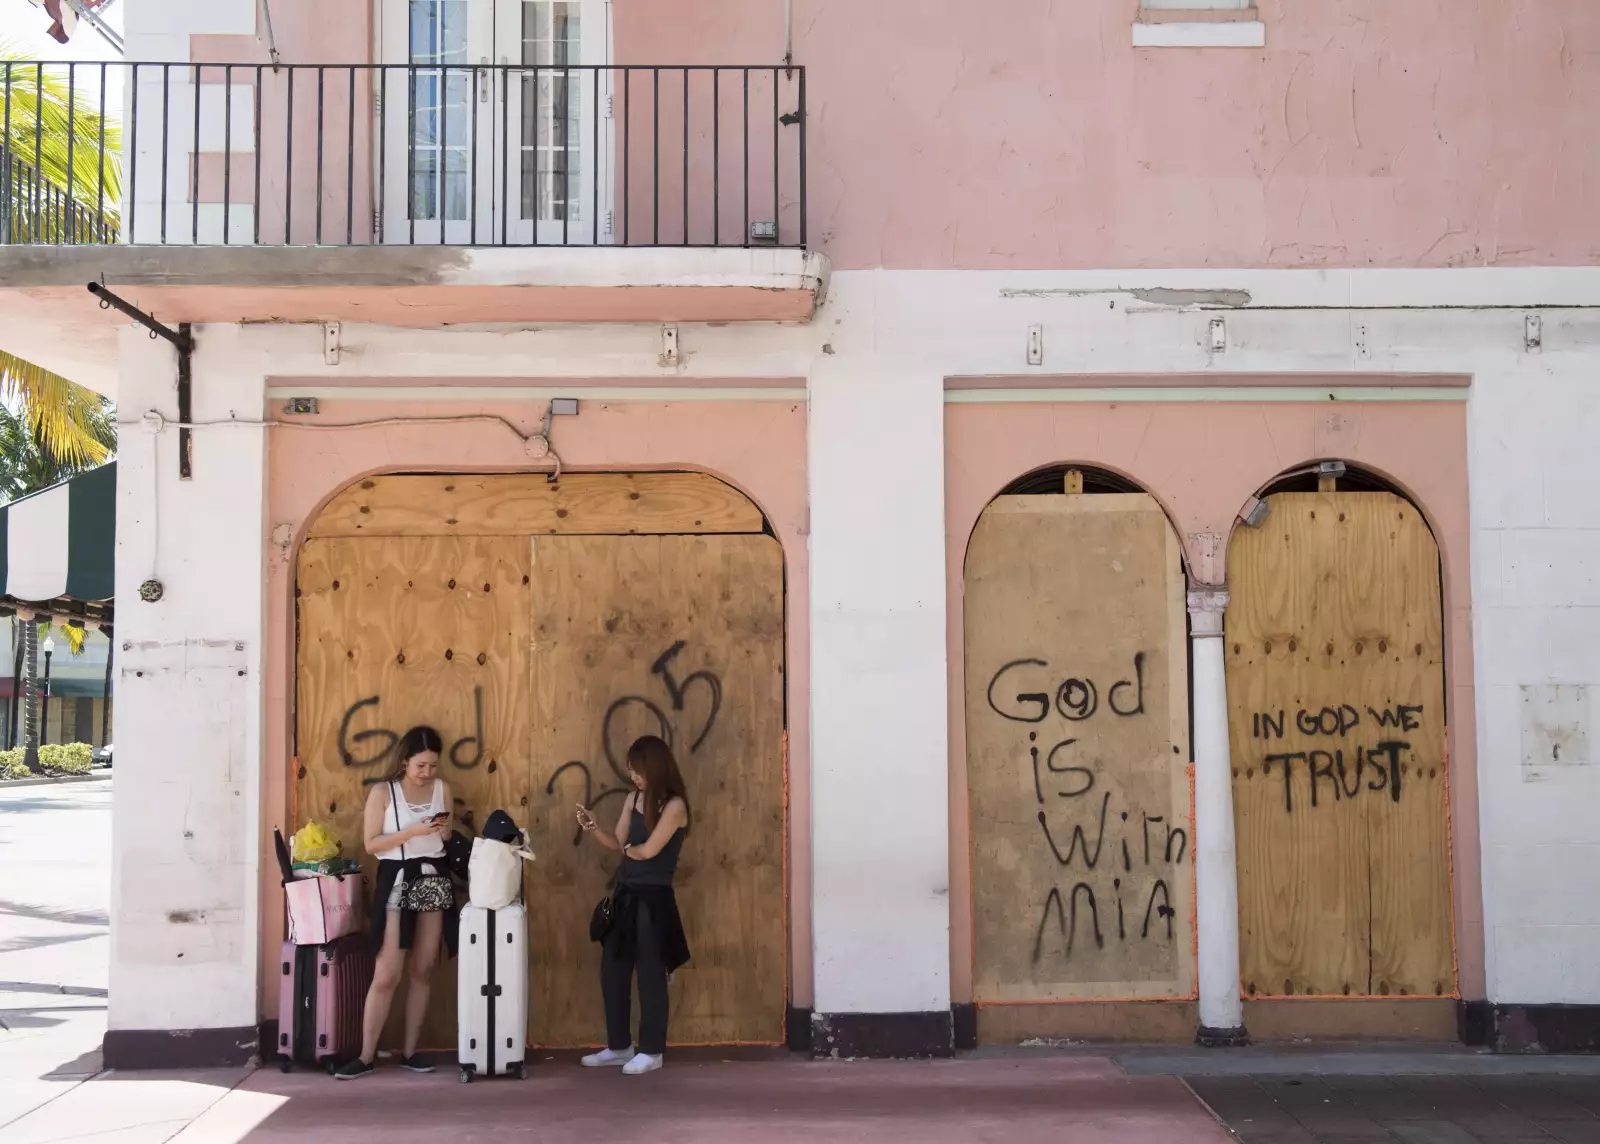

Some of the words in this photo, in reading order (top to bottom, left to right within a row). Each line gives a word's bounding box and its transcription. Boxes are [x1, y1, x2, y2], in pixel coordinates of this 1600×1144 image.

[987, 652, 1145, 723] God
[1253, 710, 1285, 740] IN
[1296, 703, 1360, 738] GOD
[1367, 704, 1424, 732] WE
[338, 685, 484, 769] Gd
[1264, 741, 1411, 813] TRUST
